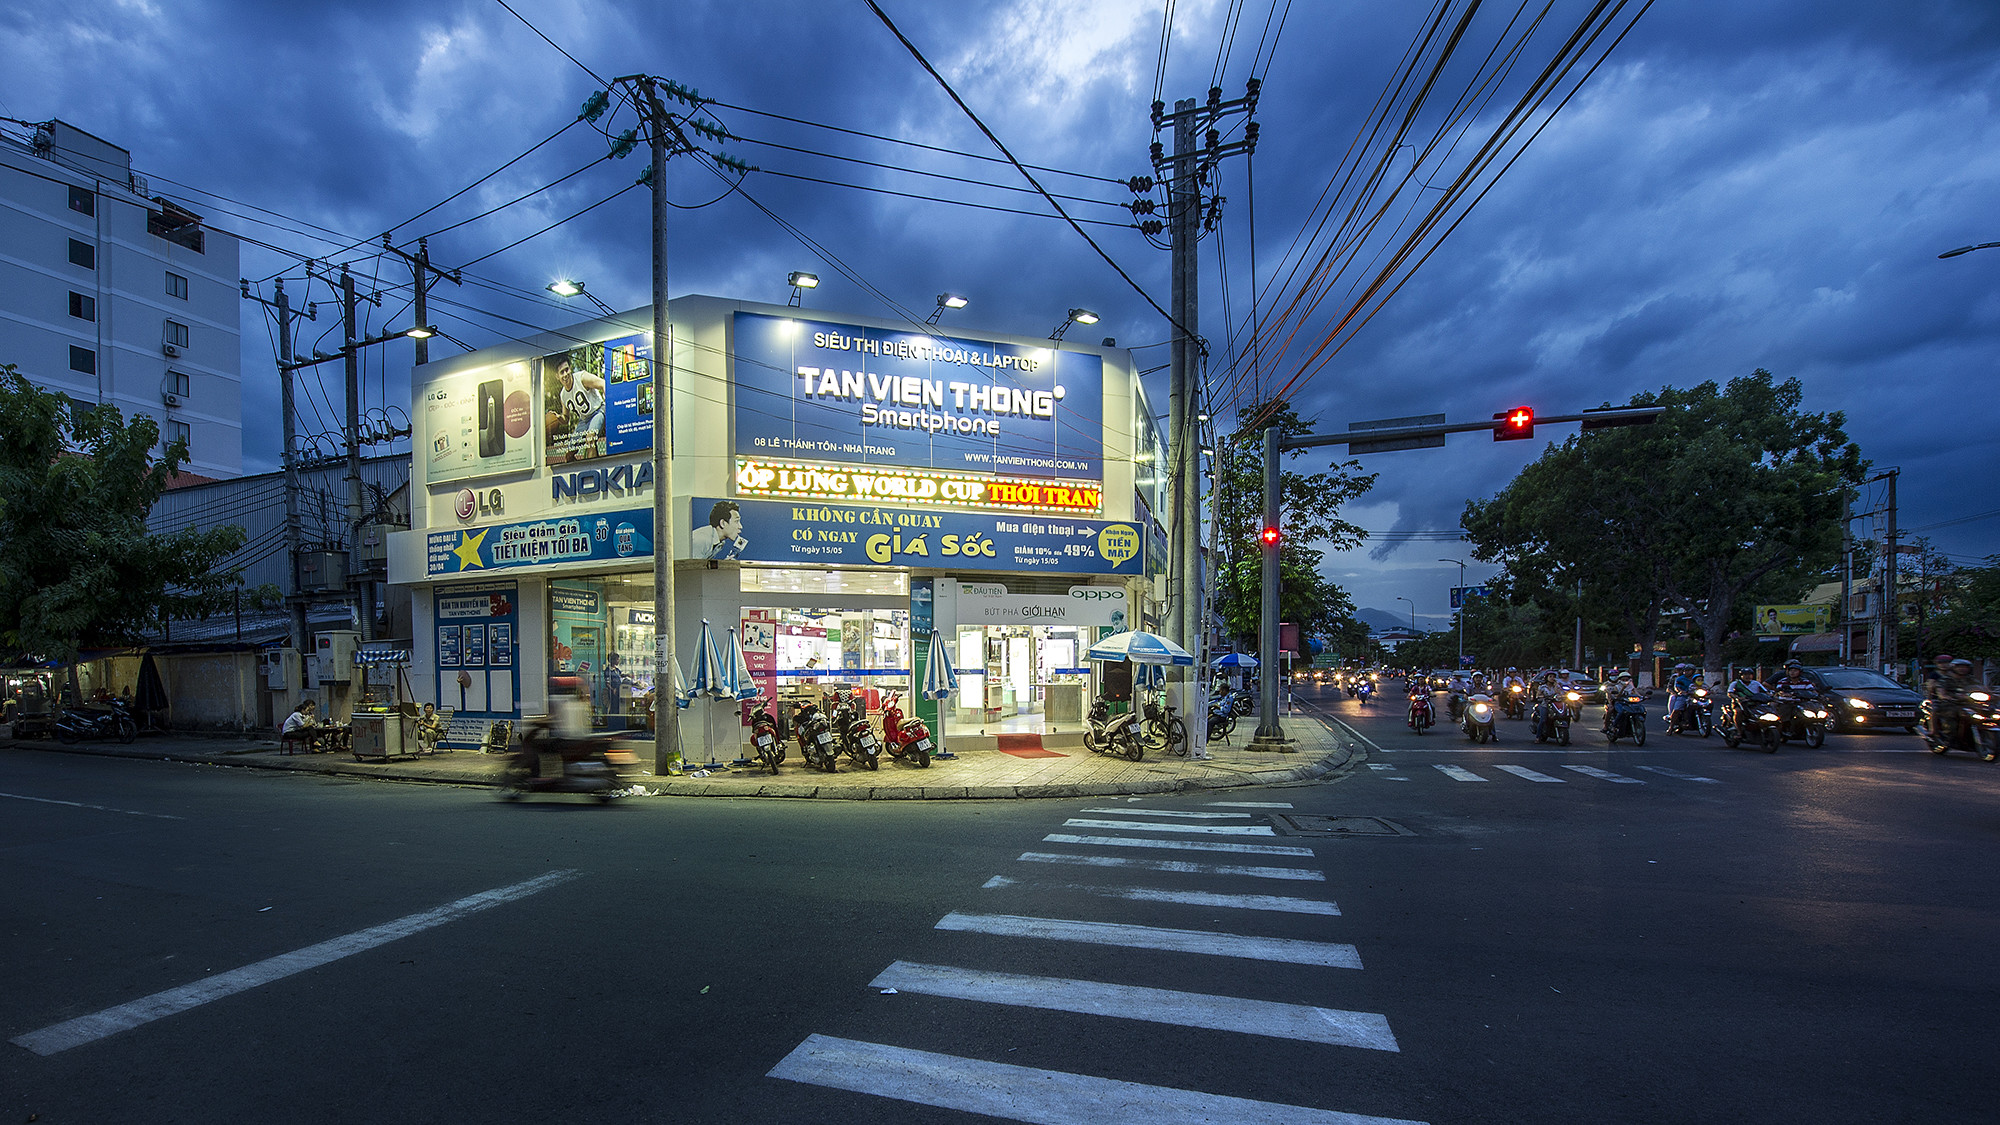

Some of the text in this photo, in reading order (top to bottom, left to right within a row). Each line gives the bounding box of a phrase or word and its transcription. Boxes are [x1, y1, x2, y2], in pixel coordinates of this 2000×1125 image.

[814, 331, 1040, 373] SIÊU THỊ ĐIỆN THOẠI & LAPTOP
[797, 366, 1054, 417] TAN VIEN THONG
[861, 403, 1000, 435] Smartphone
[754, 437, 766, 447] 08
[768, 437, 781, 448] LÊ
[783, 438, 816, 451] THÁNH
[817, 440, 837, 452] TÔN
[843, 443, 863, 454] NHA
[864, 445, 896, 456] TRANG
[964, 452, 1089, 471] WWW.TANVIENTHONG.COM.VN
[551, 461, 654, 499] NOKIA
[851, 474, 938, 498] WORLD
[940, 480, 986, 500] CUP
[478, 487, 503, 512] LG
[791, 506, 943, 528] KHÔNG CẦN QUAY
[792, 527, 858, 543] CÓ NGAY
[996, 521, 1075, 538] Mua điện thoại
[1120, 529, 1135, 537] Ngay
[494, 534, 589, 560] TIẾT KIỆM TỐI ĐA
[791, 545, 843, 555] Từ ngày 15/05
[1014, 544, 1034, 555] GIẢM
[1034, 547, 1053, 555] 10%
[1063, 544, 1095, 557] 49%
[1106, 536, 1131, 547] TIỀN
[1014, 556, 1059, 565] Từ ngày 15/05
[1107, 547, 1131, 560] MẶT
[984, 604, 1066, 619] BỨT PHÁ GIỚI HẠN
